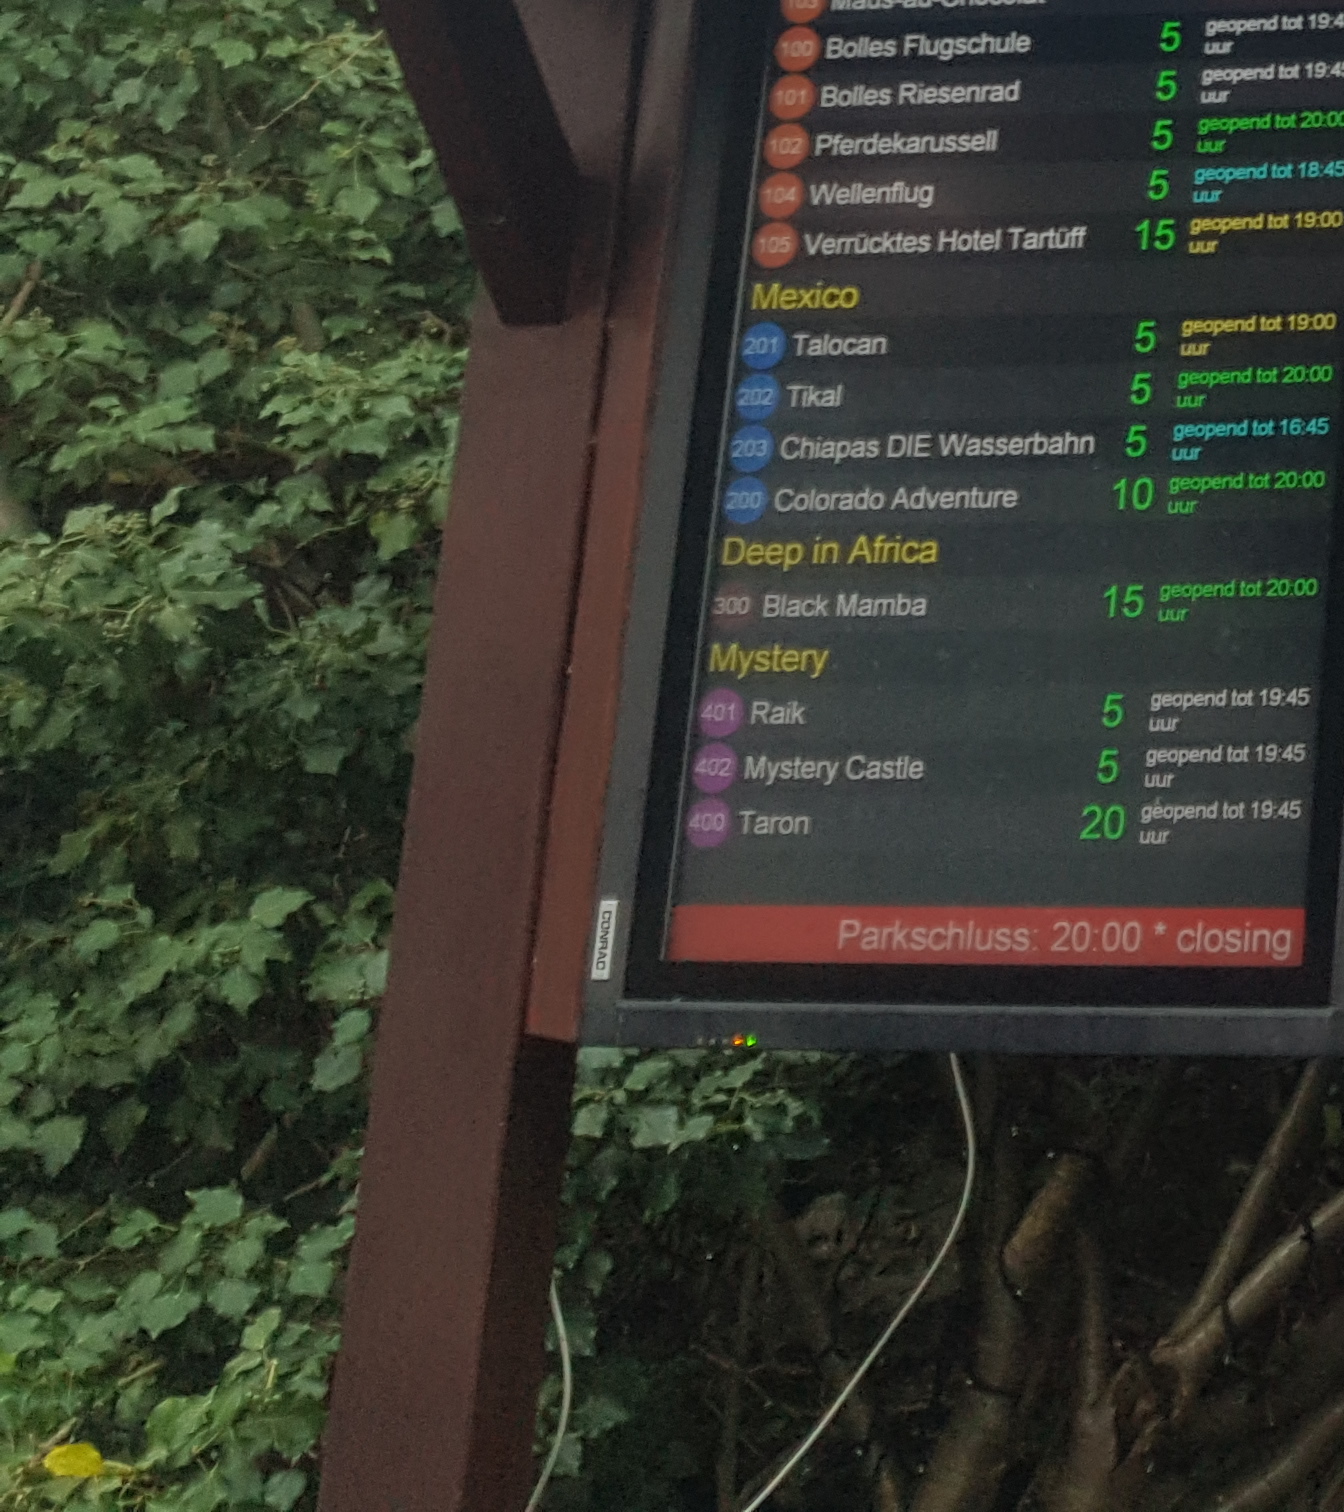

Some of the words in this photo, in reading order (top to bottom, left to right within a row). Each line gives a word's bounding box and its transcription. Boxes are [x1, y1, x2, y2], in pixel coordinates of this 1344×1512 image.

[827, 37, 896, 58] Bolles
[904, 32, 1031, 60] Flugschule
[821, 86, 891, 107] Bolles
[899, 81, 1020, 104] Riesenrad
[815, 130, 997, 155] Pferdekarussell
[810, 182, 934, 208] Wellenflug
[805, 232, 931, 254] Verrücktes
[938, 229, 1001, 251] Hotel
[1008, 227, 1086, 249] Tartüff
[1135, 219, 1175, 250] 15
[753, 284, 858, 310] Mexico
[794, 334, 887, 355] Talocan
[787, 385, 842, 407] Tikal
[781, 436, 879, 463] Chiapas
[887, 435, 931, 457] DIE
[939, 432, 1094, 456] Wasserbahn
[775, 488, 884, 512] Colorado
[891, 487, 1017, 509] Adventure
[1114, 478, 1153, 510] 10
[723, 538, 803, 571] Deep
[813, 538, 839, 564] in
[848, 535, 937, 563] Africa
[763, 595, 828, 617] Black
[837, 594, 926, 616] Mamba
[1104, 585, 1143, 617] 15
[710, 644, 828, 679] Mystery
[751, 701, 805, 724] Raik
[745, 756, 839, 785] Mystery
[846, 755, 923, 780] Castle
[739, 811, 809, 835] Taron
[1080, 806, 1124, 839] 20
[596, 910, 612, 970] CONRAC
[839, 920, 1037, 951] Parkschluss:
[1051, 922, 1140, 952] 20:00
[1177, 922, 1291, 960] closing
